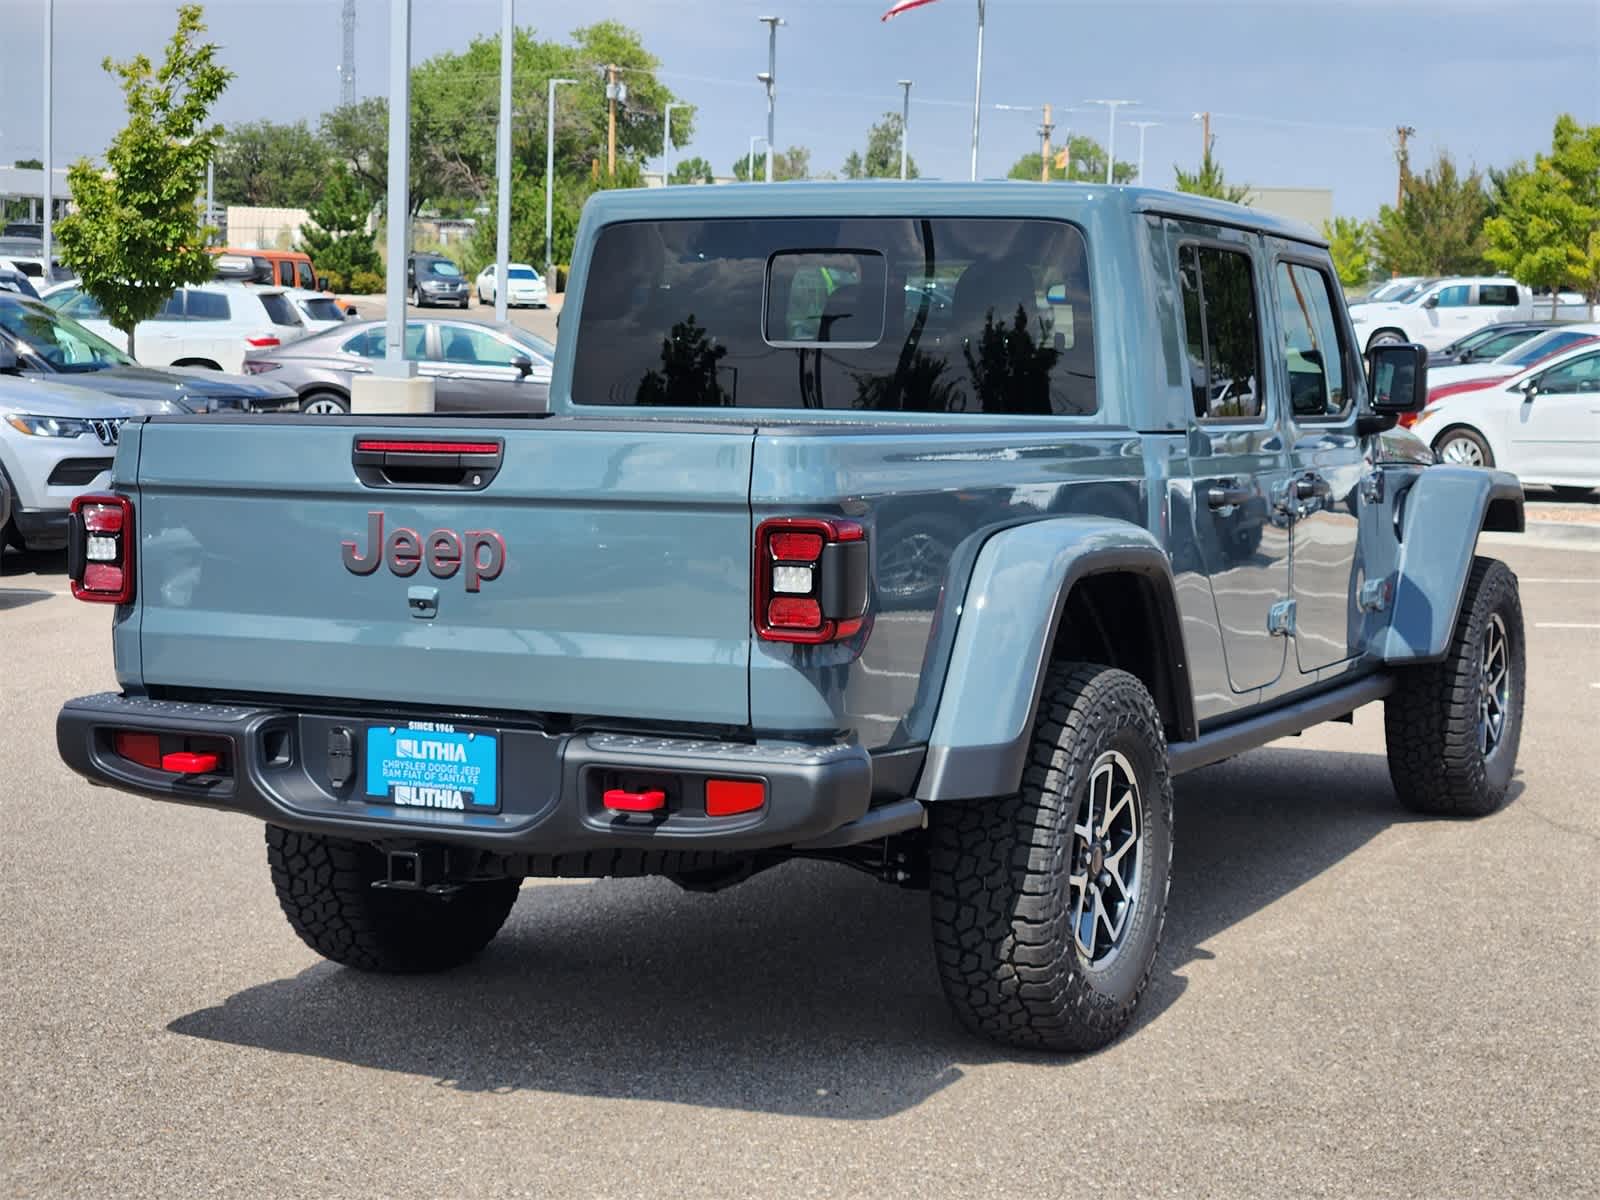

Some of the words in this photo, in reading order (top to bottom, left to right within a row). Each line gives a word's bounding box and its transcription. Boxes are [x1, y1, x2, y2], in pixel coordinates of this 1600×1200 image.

[341, 511, 506, 593] Jeep
[408, 721, 434, 732] SINCE
[412, 739, 467, 763] LITHIA
[382, 759, 426, 771] CHRYSLER
[427, 763, 459, 774] DODGE
[460, 766, 481, 775] JEEP
[382, 769, 402, 778] RAM
[403, 770, 422, 779] FIAT
[424, 771, 436, 780] OF
[438, 773, 465, 783] SANTA
[468, 776, 480, 785] FE
[411, 786, 465, 810] LITHIA
